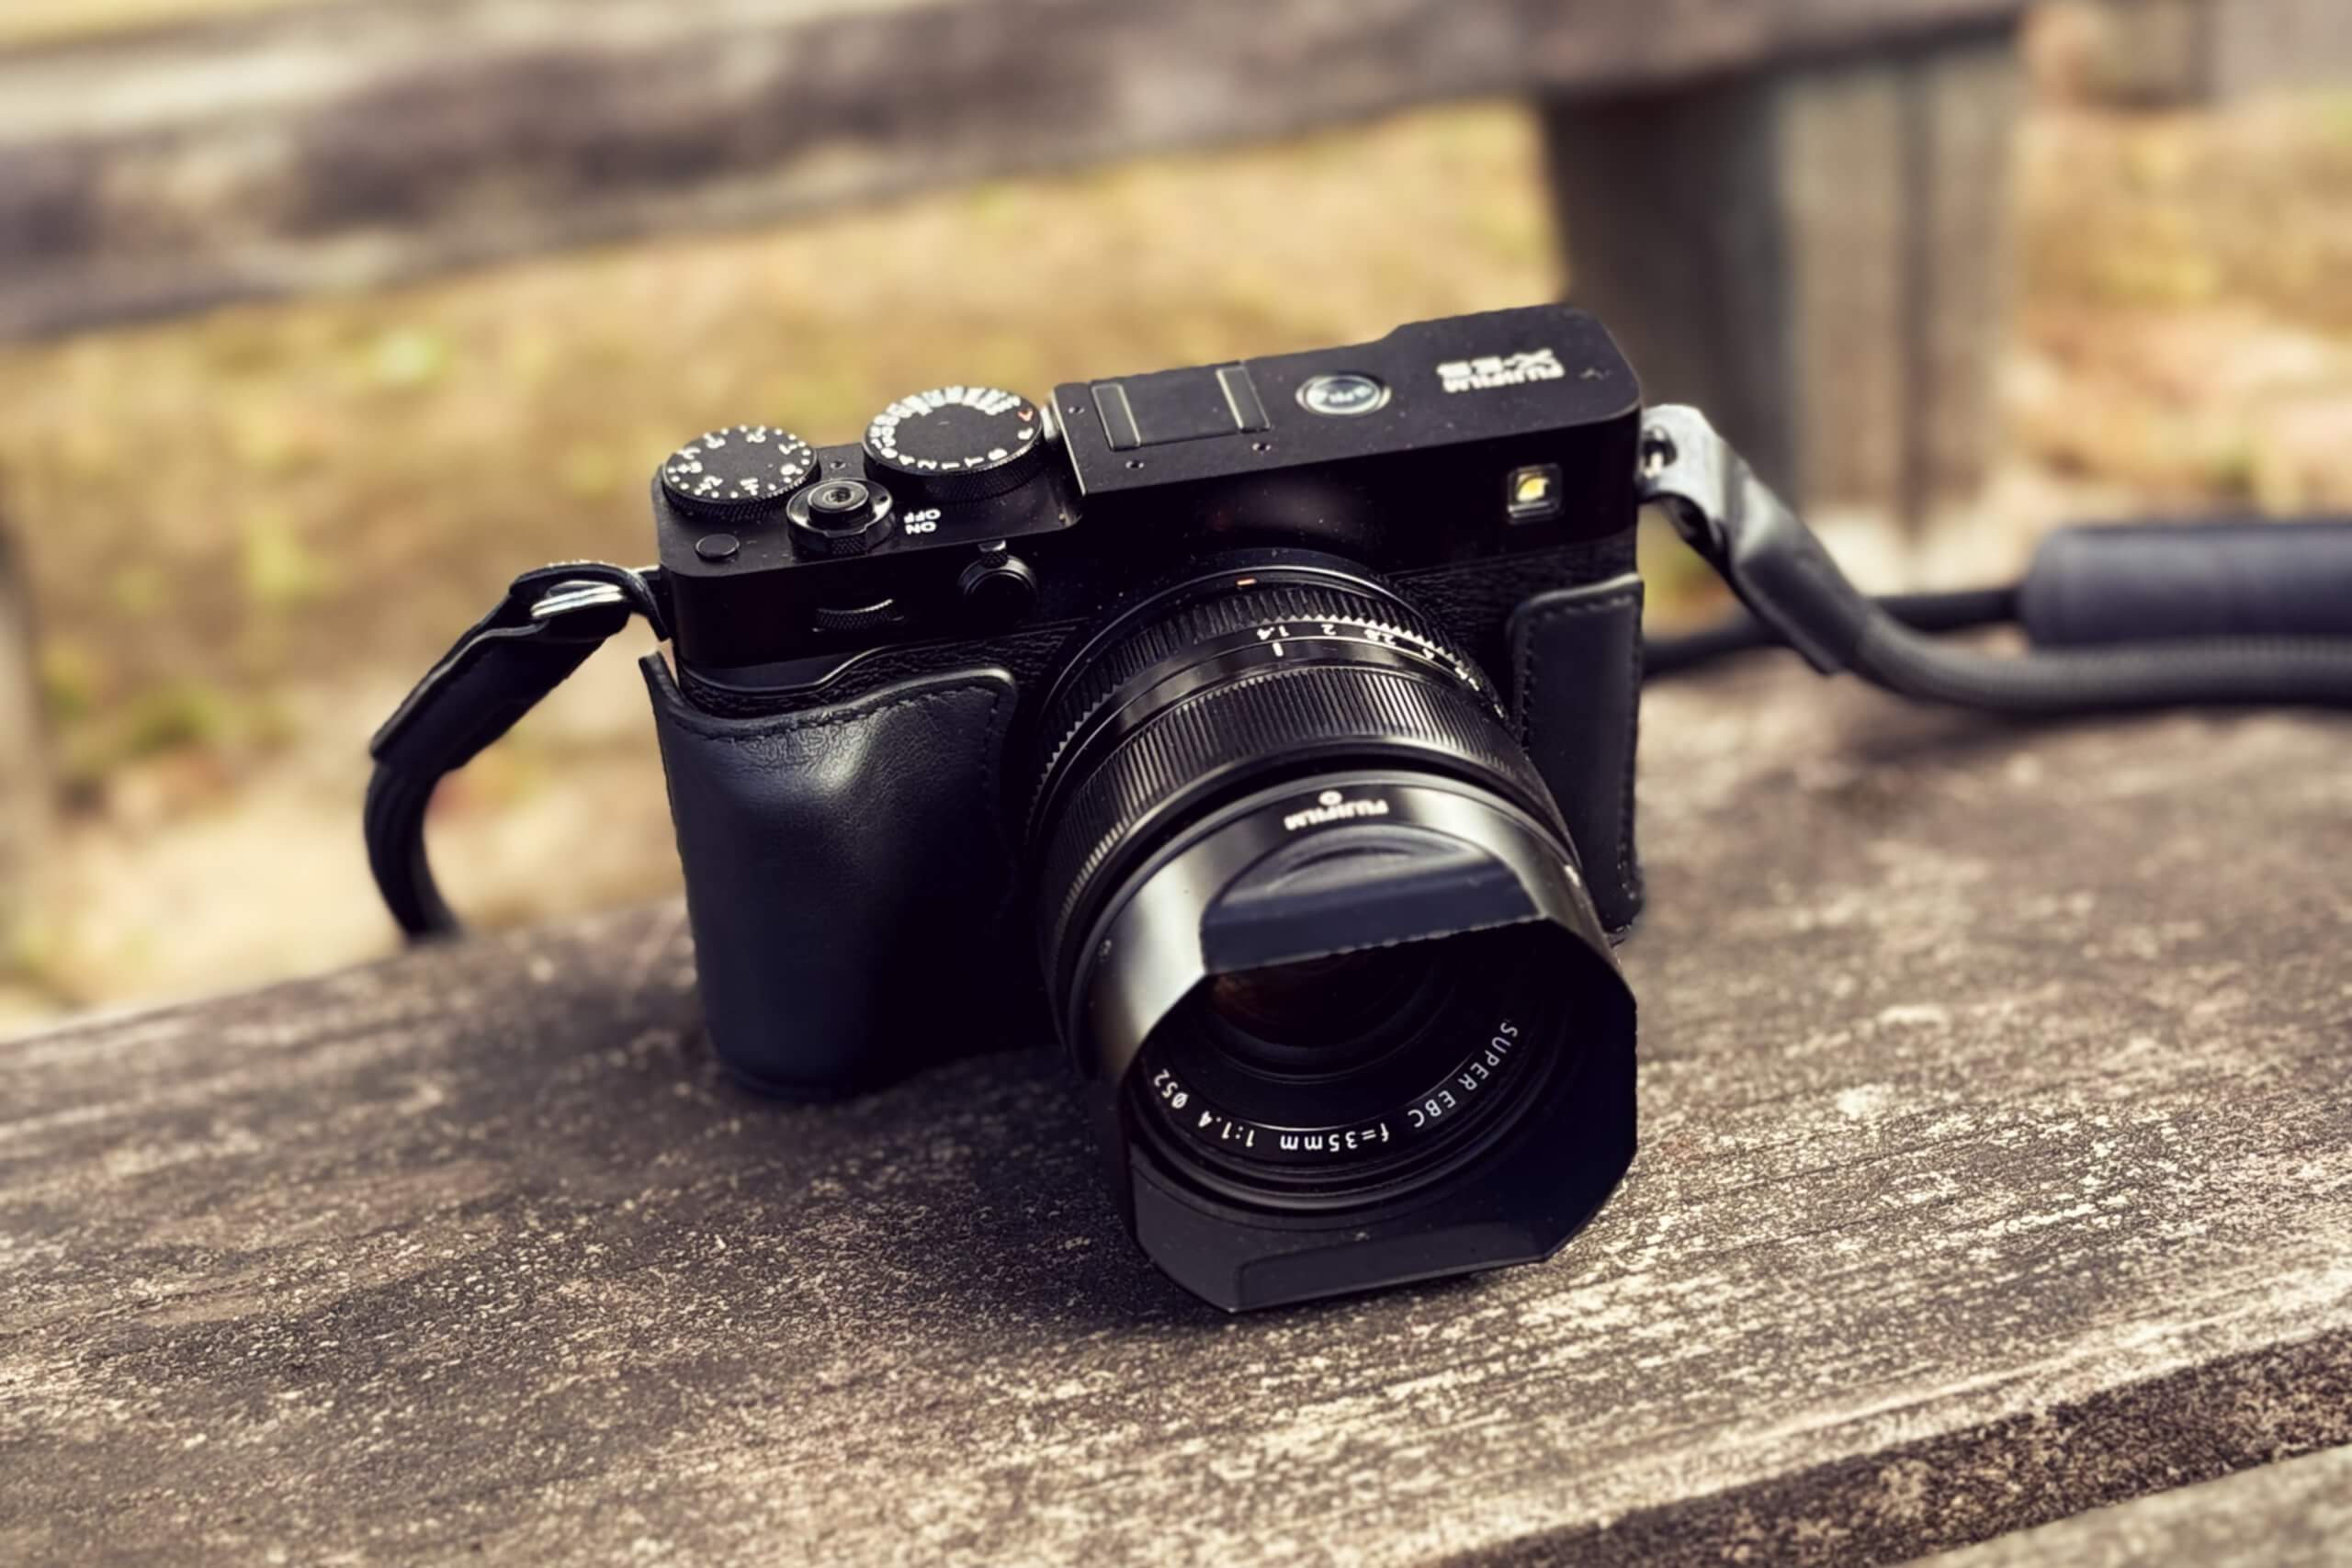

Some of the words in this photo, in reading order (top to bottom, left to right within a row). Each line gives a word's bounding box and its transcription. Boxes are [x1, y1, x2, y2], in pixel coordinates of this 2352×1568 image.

[903, 508, 942, 525] OFF
[906, 522, 937, 536] ON
[1257, 625, 1291, 640] 1.4
[1320, 624, 1337, 636] 2
[1283, 799, 1390, 831] FUJIFILM
[1458, 1021, 1519, 1091] SUPER
[1408, 1089, 1457, 1129] EBC
[1197, 1111, 1256, 1149] 1:1.4
[1279, 1122, 1390, 1153] f=35mm
